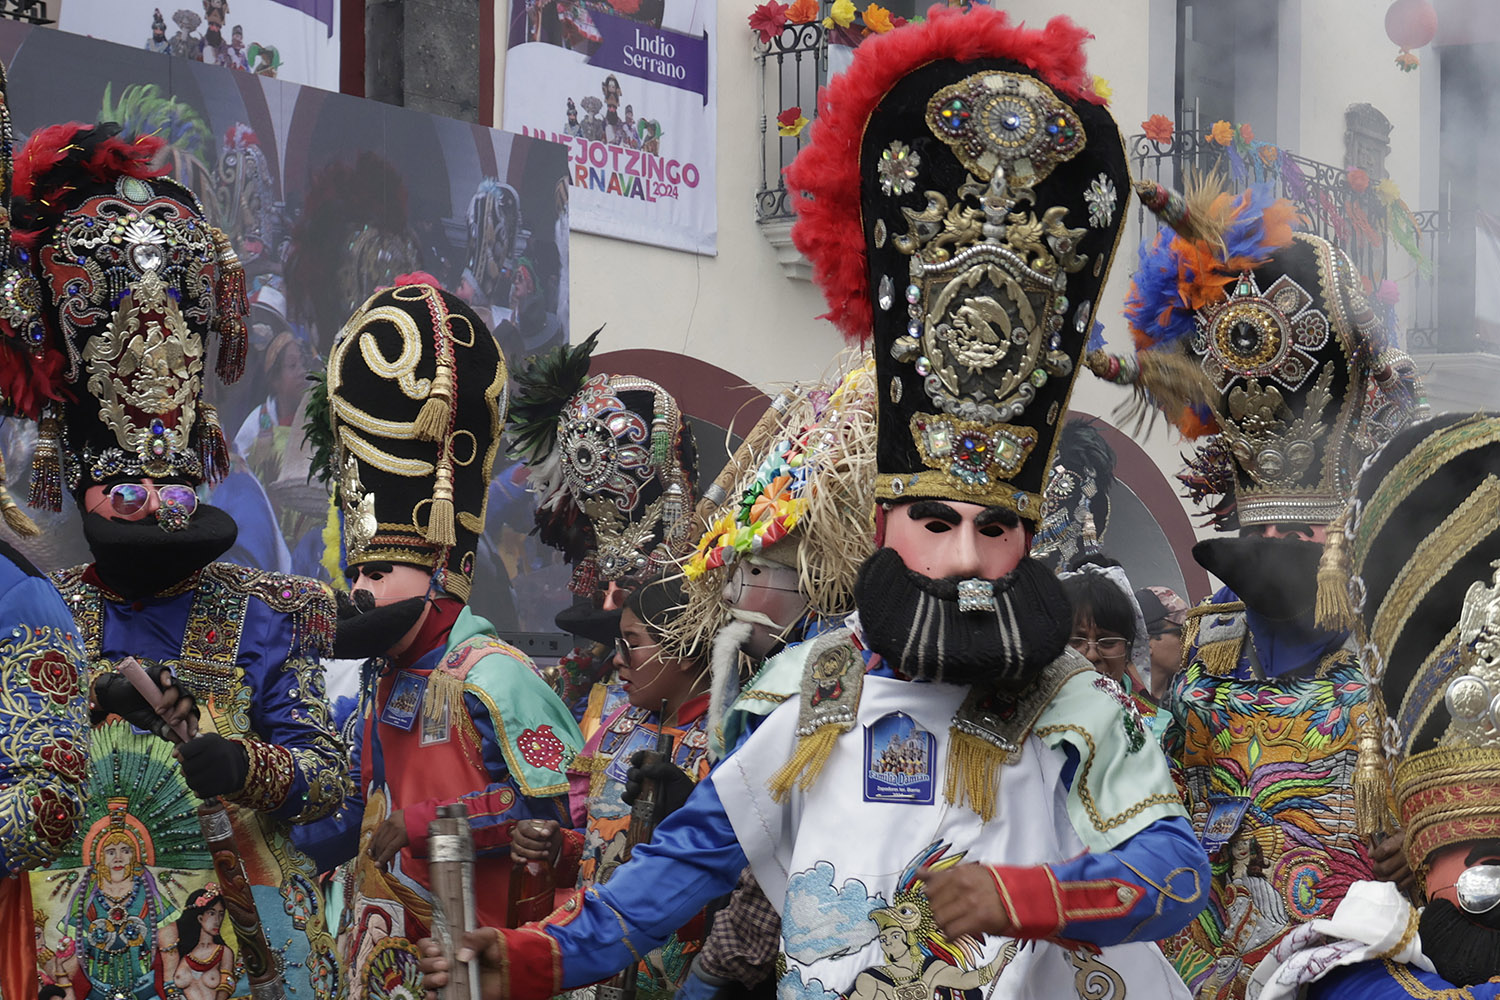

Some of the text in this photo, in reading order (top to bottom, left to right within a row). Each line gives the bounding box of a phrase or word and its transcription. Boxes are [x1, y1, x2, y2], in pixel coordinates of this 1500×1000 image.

[635, 28, 676, 59] Indio
[623, 45, 686, 80] Serrano
[568, 164, 679, 203] RNAVAL 2024
